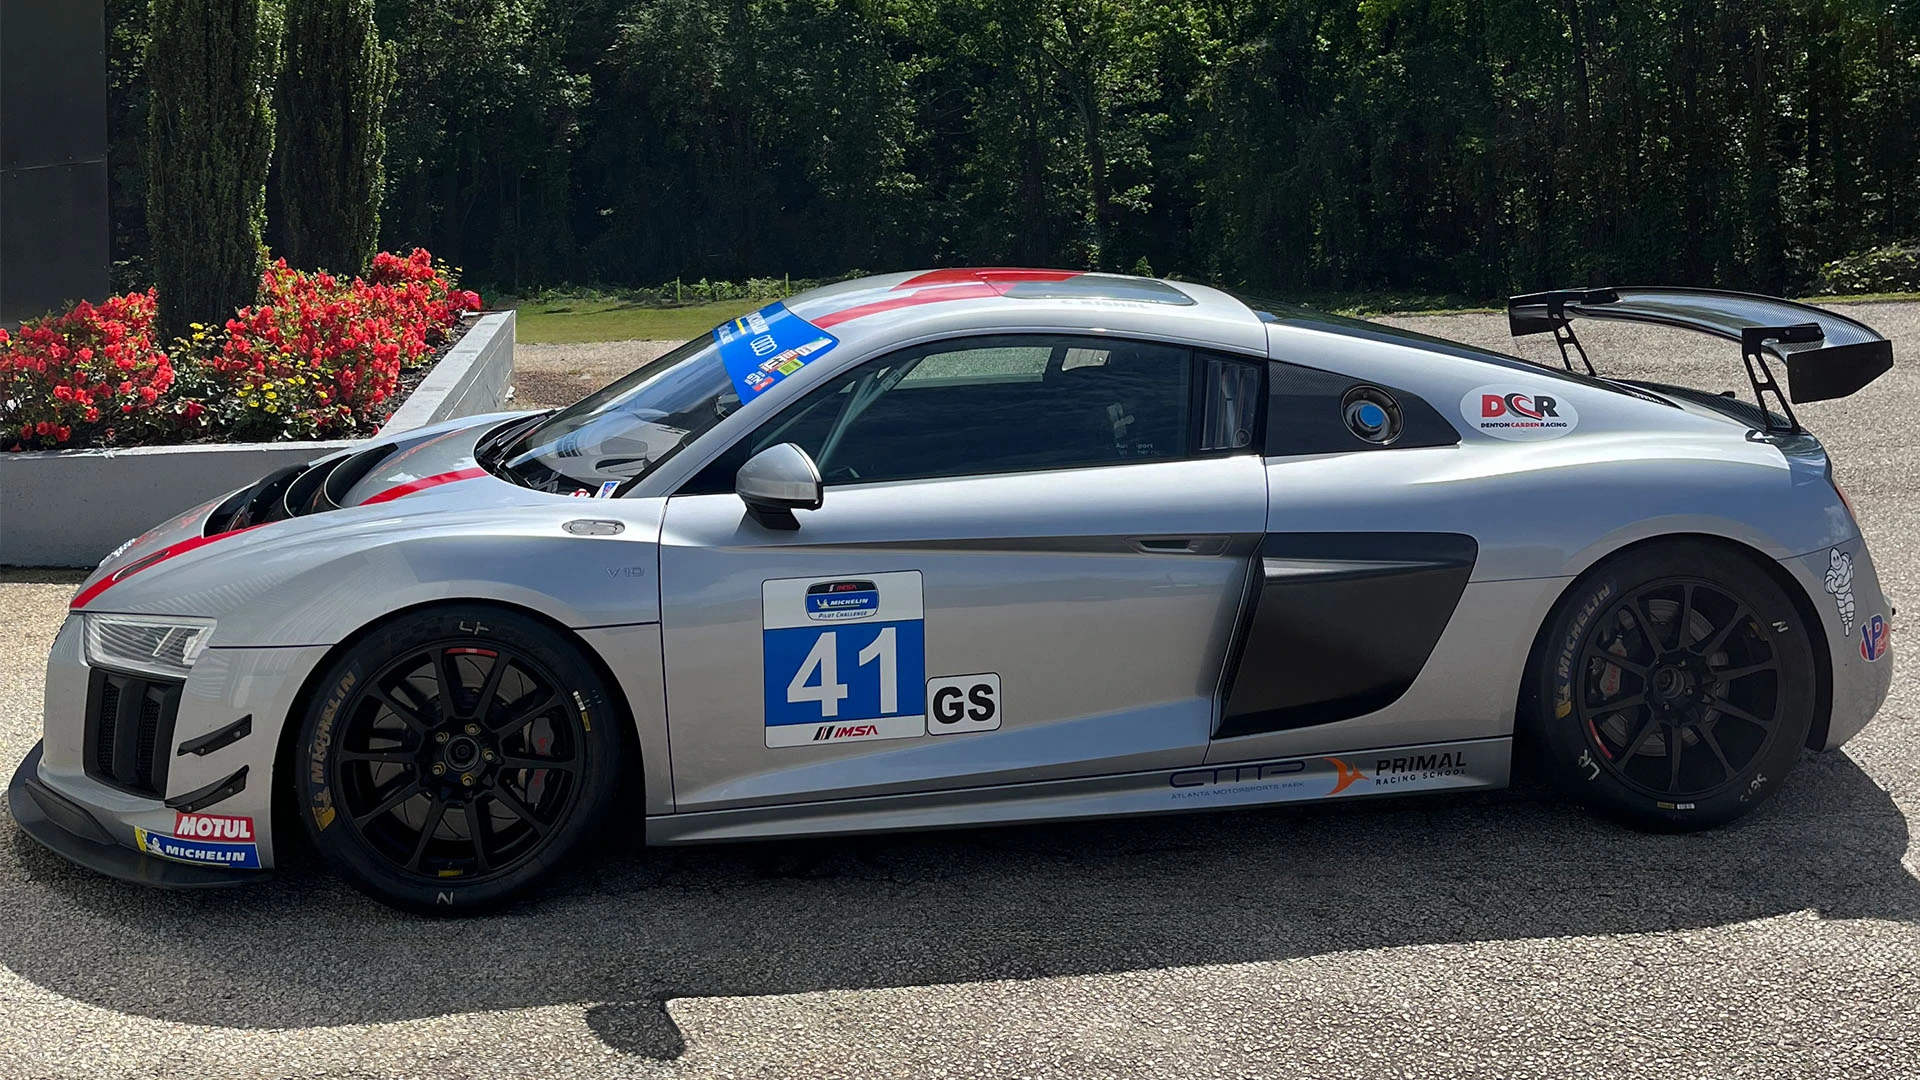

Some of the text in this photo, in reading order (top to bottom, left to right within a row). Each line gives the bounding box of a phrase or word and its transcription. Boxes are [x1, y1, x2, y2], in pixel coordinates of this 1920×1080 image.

[1482, 393, 1559, 420] DCR
[606, 567, 645, 578] V10
[829, 598, 869, 606] MICHELIN
[1557, 583, 1612, 680] MICHELIN
[1862, 616, 1883, 660] VP
[786, 626, 898, 718] 41
[932, 684, 996, 724] GS
[834, 725, 879, 738] IMSA
[1375, 751, 1467, 776] PRIMAL
[1375, 769, 1467, 786] RACING SCHOOL
[1171, 781, 1306, 800] ATLANTA MOTORSPORTS PARK
[176, 816, 251, 839] MOTUL
[165, 844, 246, 862] MICHELIN
